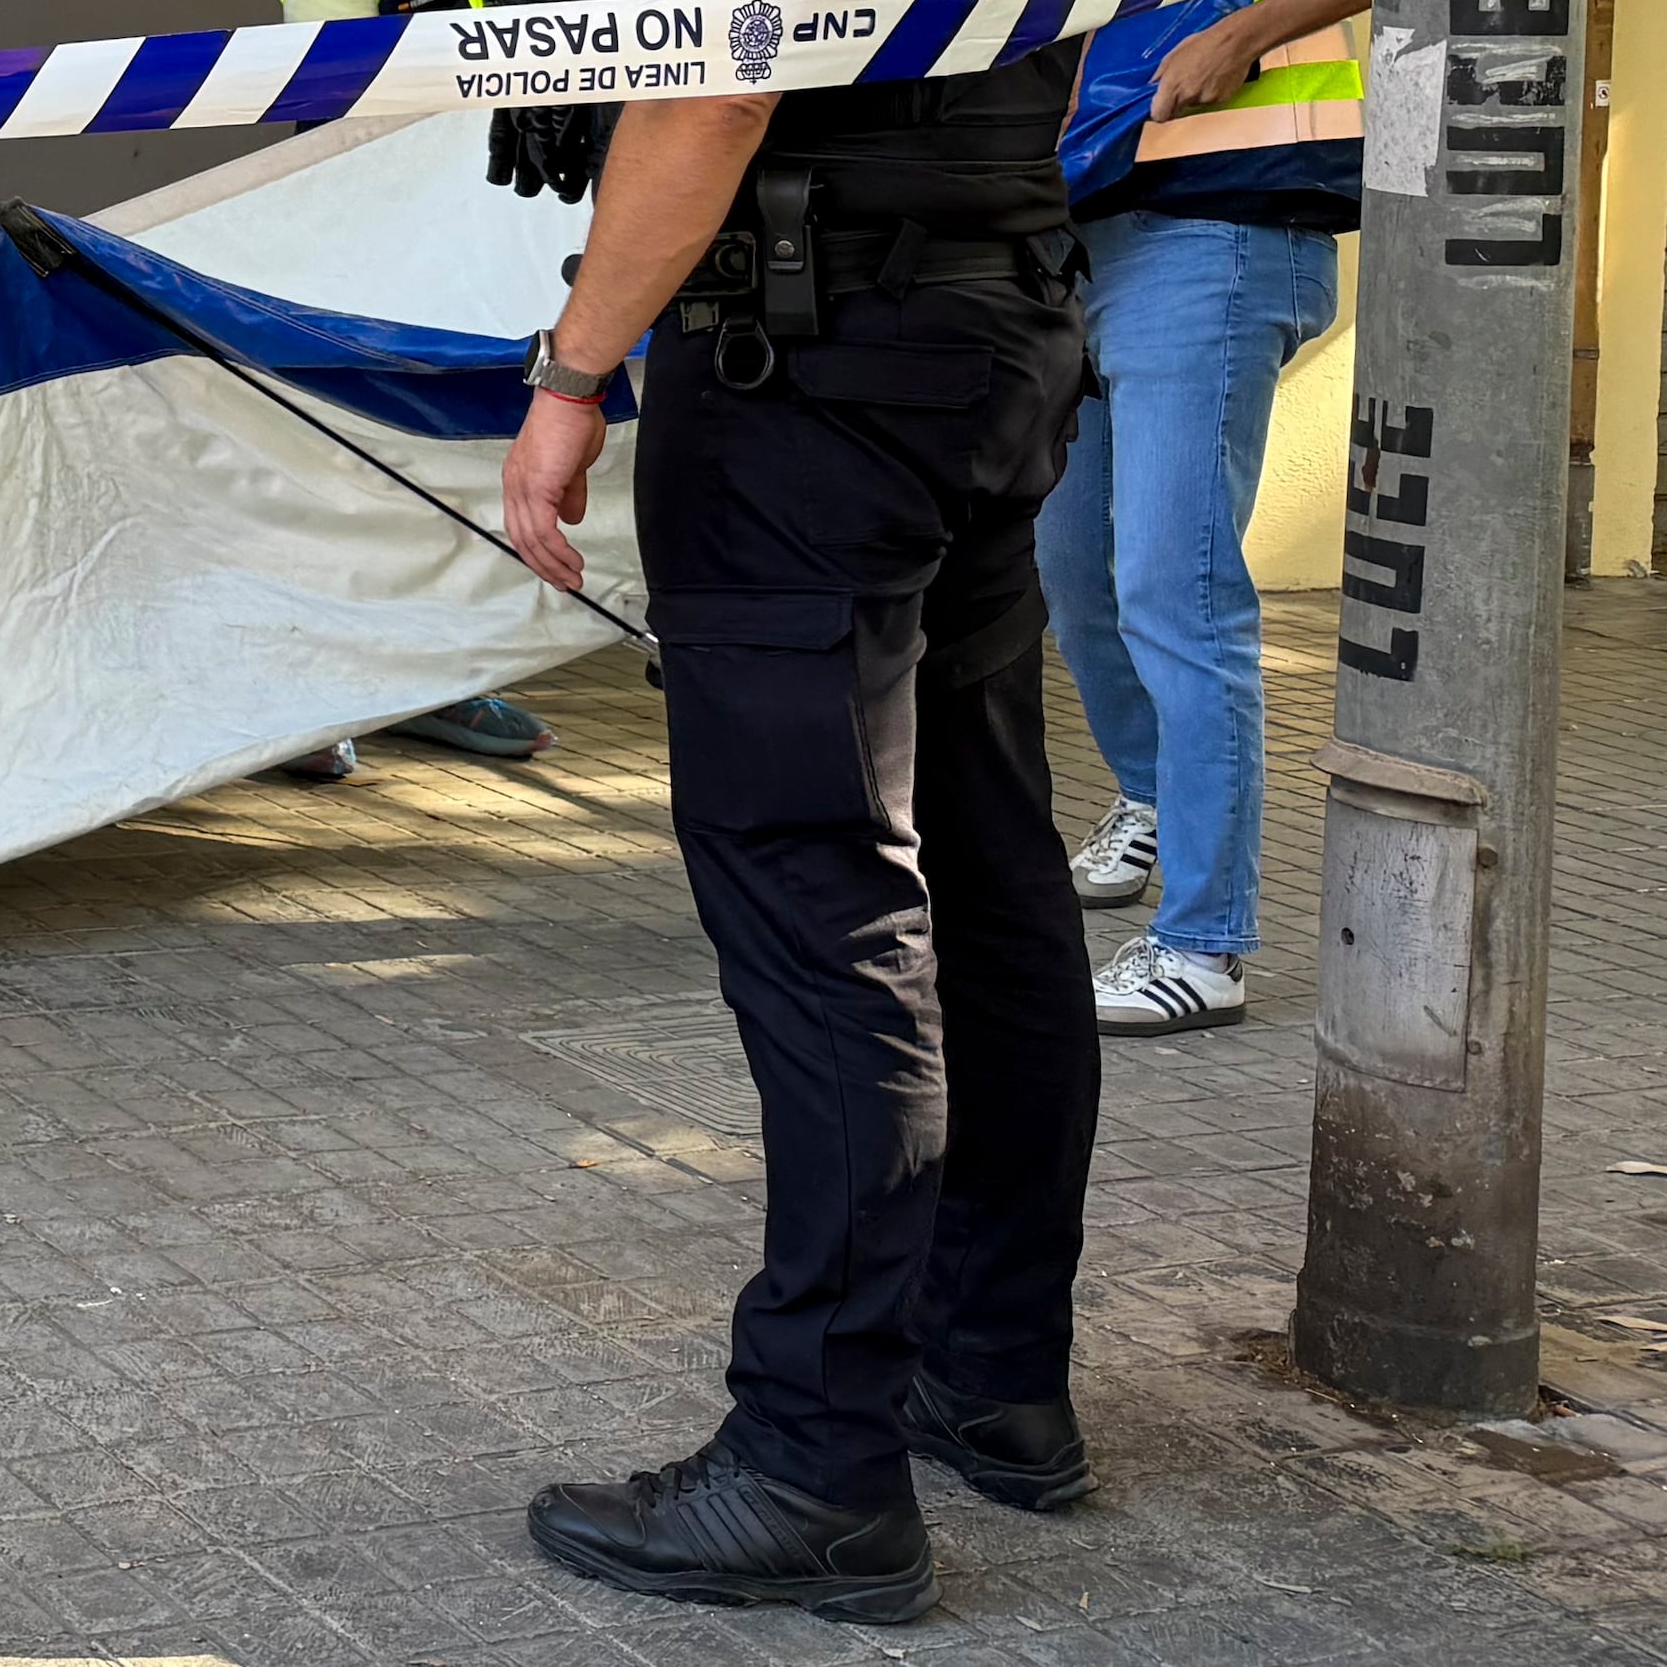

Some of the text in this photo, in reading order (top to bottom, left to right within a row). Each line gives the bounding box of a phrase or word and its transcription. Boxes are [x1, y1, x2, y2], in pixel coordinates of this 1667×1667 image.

[448, 6, 703, 60] NO PASAR
[792, 7, 877, 42] CNP
[455, 61, 706, 98] LINEA DE POLICIA
